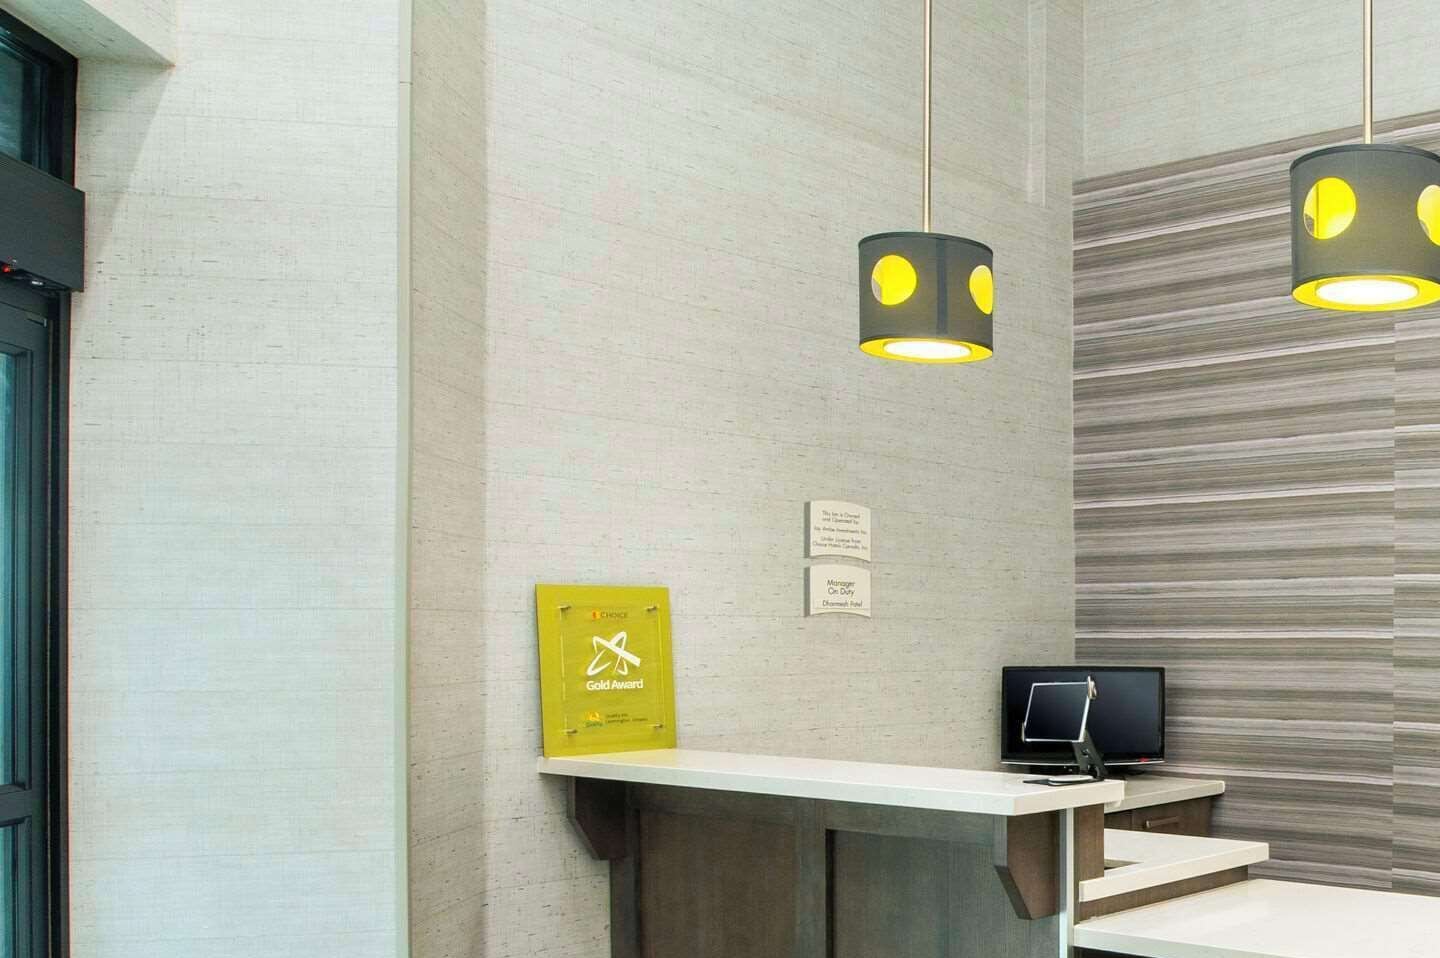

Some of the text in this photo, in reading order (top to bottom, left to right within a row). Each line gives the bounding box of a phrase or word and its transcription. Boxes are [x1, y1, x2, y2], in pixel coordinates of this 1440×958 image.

[827, 580, 855, 589] Manager
[828, 587, 855, 597] On Duty
[586, 678, 644, 691] Gold Award
